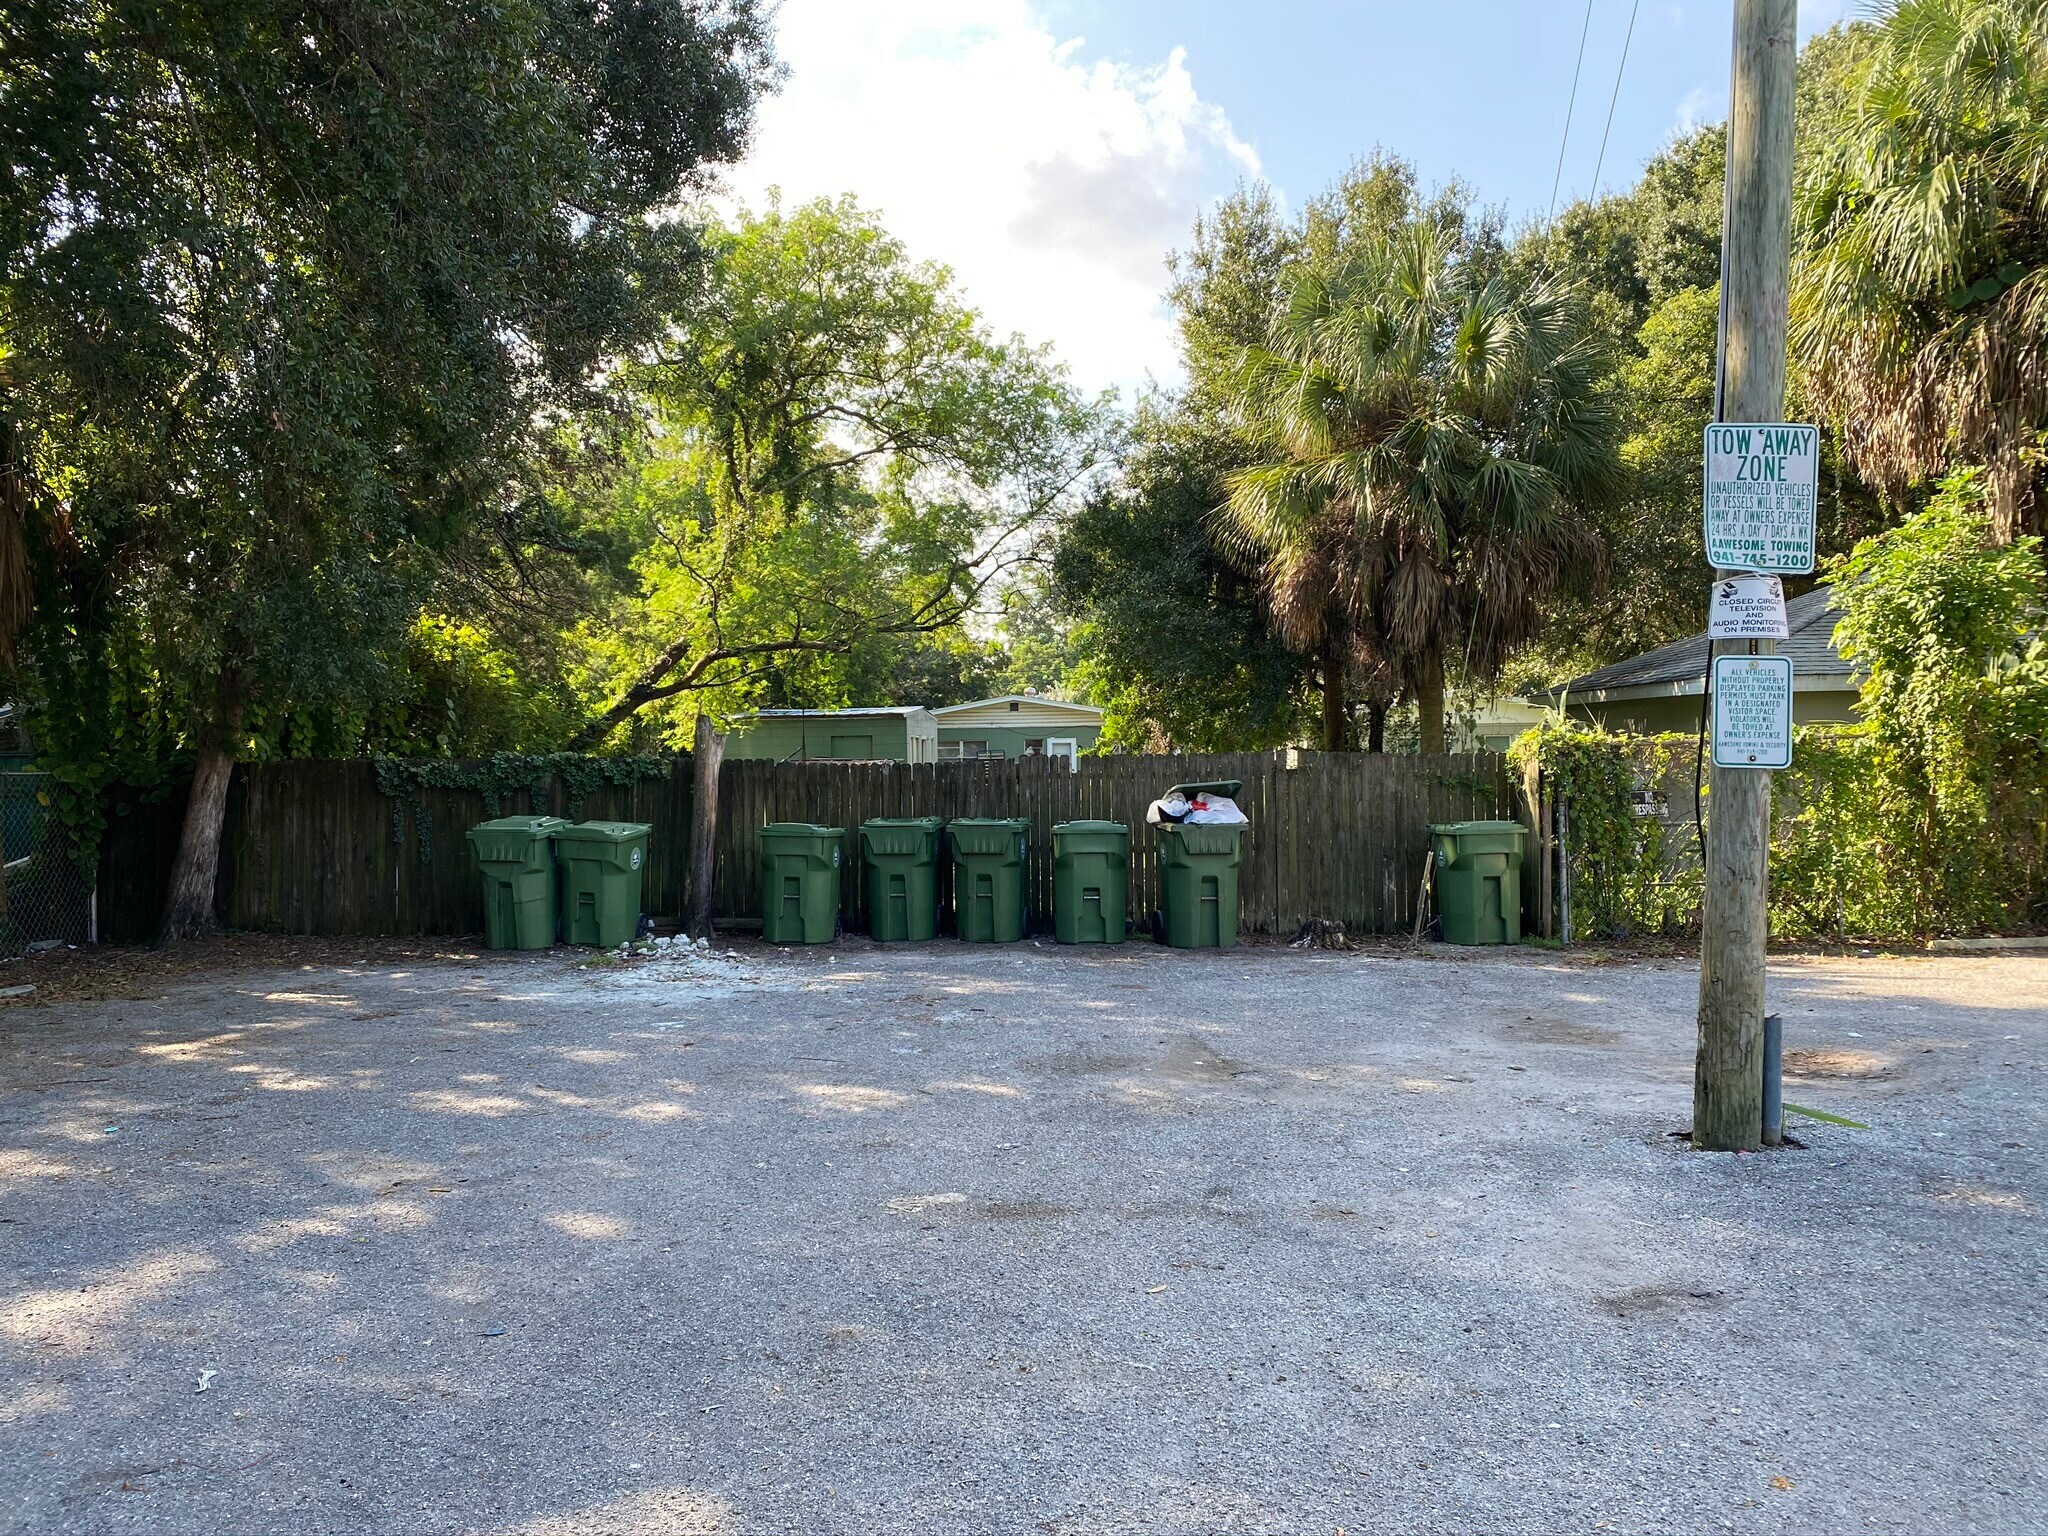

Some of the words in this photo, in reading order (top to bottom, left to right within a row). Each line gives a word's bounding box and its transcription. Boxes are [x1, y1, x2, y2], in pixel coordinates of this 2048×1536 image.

[1712, 429, 1751, 454] TOW
[1762, 429, 1812, 456] AWAY
[1737, 456, 1787, 481] ZONE
[1711, 482, 1771, 495] UNAUTHORIZED
[1775, 483, 1810, 496] VEHICLES
[1711, 495, 1720, 509] OR
[1724, 496, 1753, 509] VESSELS
[1757, 497, 1772, 509] WILL
[1777, 497, 1785, 510] BE
[1788, 498, 1810, 510] TOWED
[1711, 510, 1728, 523] AWAY
[1732, 510, 1741, 523] AT
[1745, 510, 1774, 524] OWNERS
[1779, 512, 1809, 525] EXPENSE
[1712, 524, 1719, 536] 24
[1723, 524, 1736, 536] HRS
[1740, 525, 1745, 537] A
[1748, 525, 1760, 537] DAY
[1764, 526, 1767, 537] 7
[1771, 526, 1787, 538] DAYS
[1791, 526, 1795, 538] A
[1798, 526, 1808, 539] WK
[1712, 539, 1765, 551] AAWESOME
[1771, 541, 1808, 552] TOWING
[1714, 552, 1808, 566] 941-745-1200
[1645, 792, 1653, 803] NO
